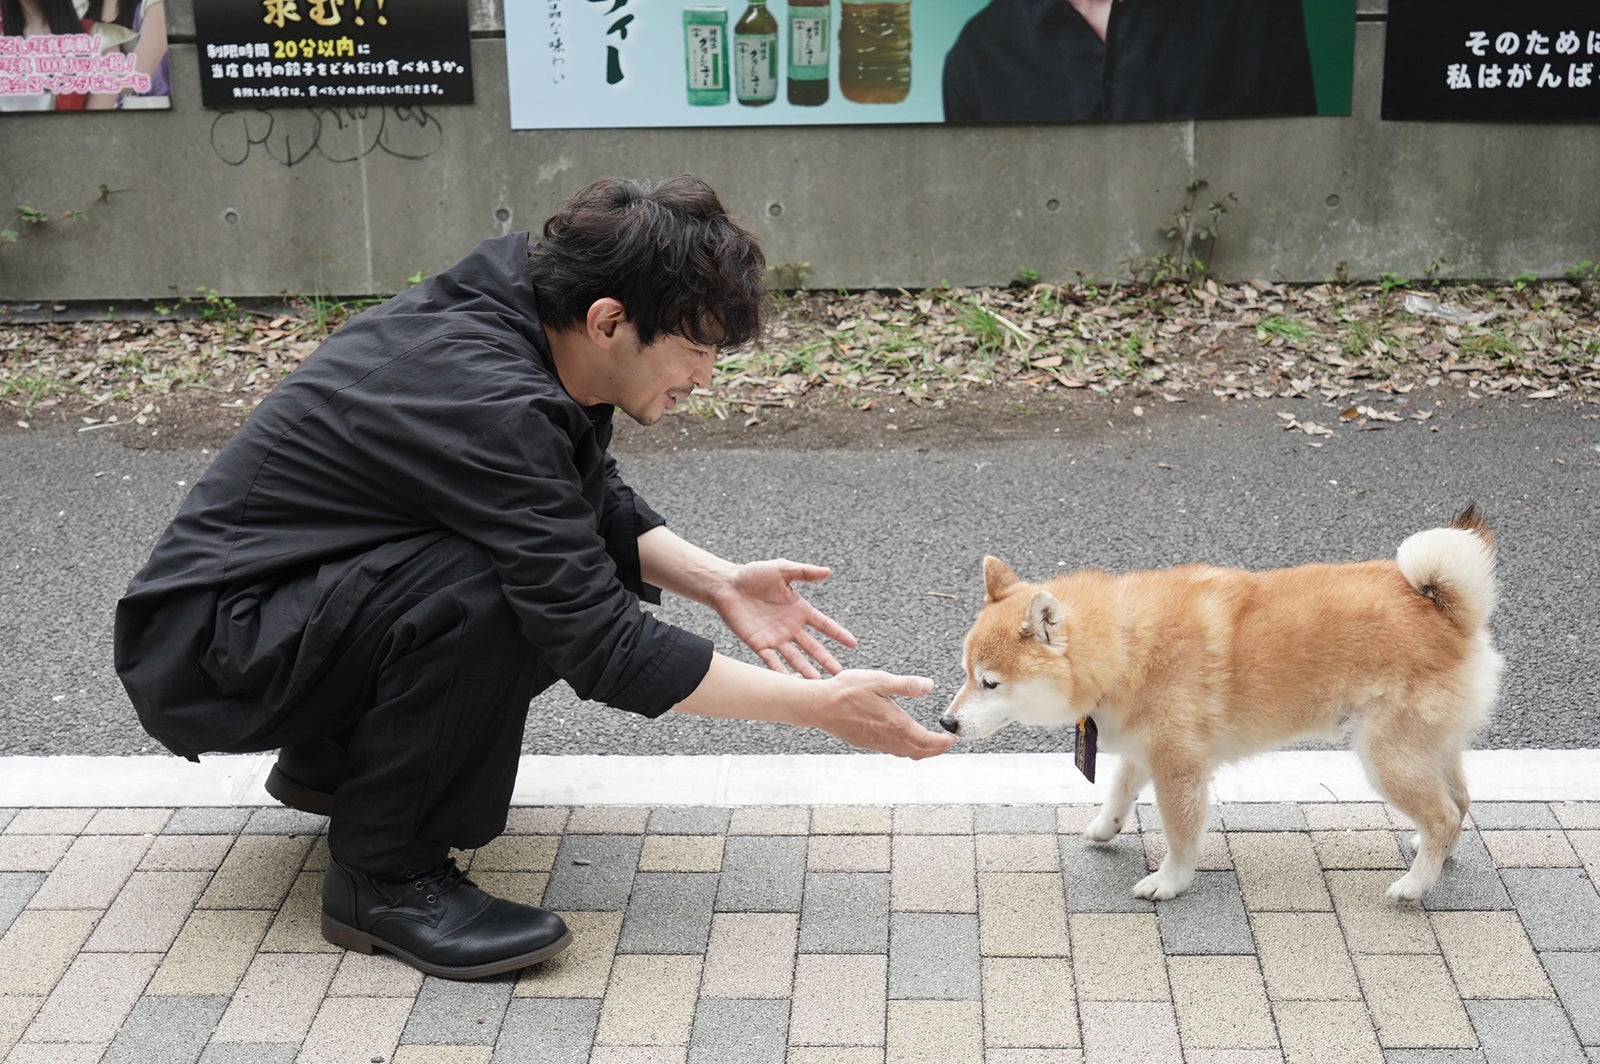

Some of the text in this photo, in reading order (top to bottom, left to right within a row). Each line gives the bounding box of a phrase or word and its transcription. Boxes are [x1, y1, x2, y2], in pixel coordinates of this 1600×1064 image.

[206, 36, 373, 59] 制限時間 20分以内 に
[547, 0, 566, 84] 品な味わい
[1465, 30, 1600, 57] そのために
[1446, 62, 1600, 90] 私はがんば
